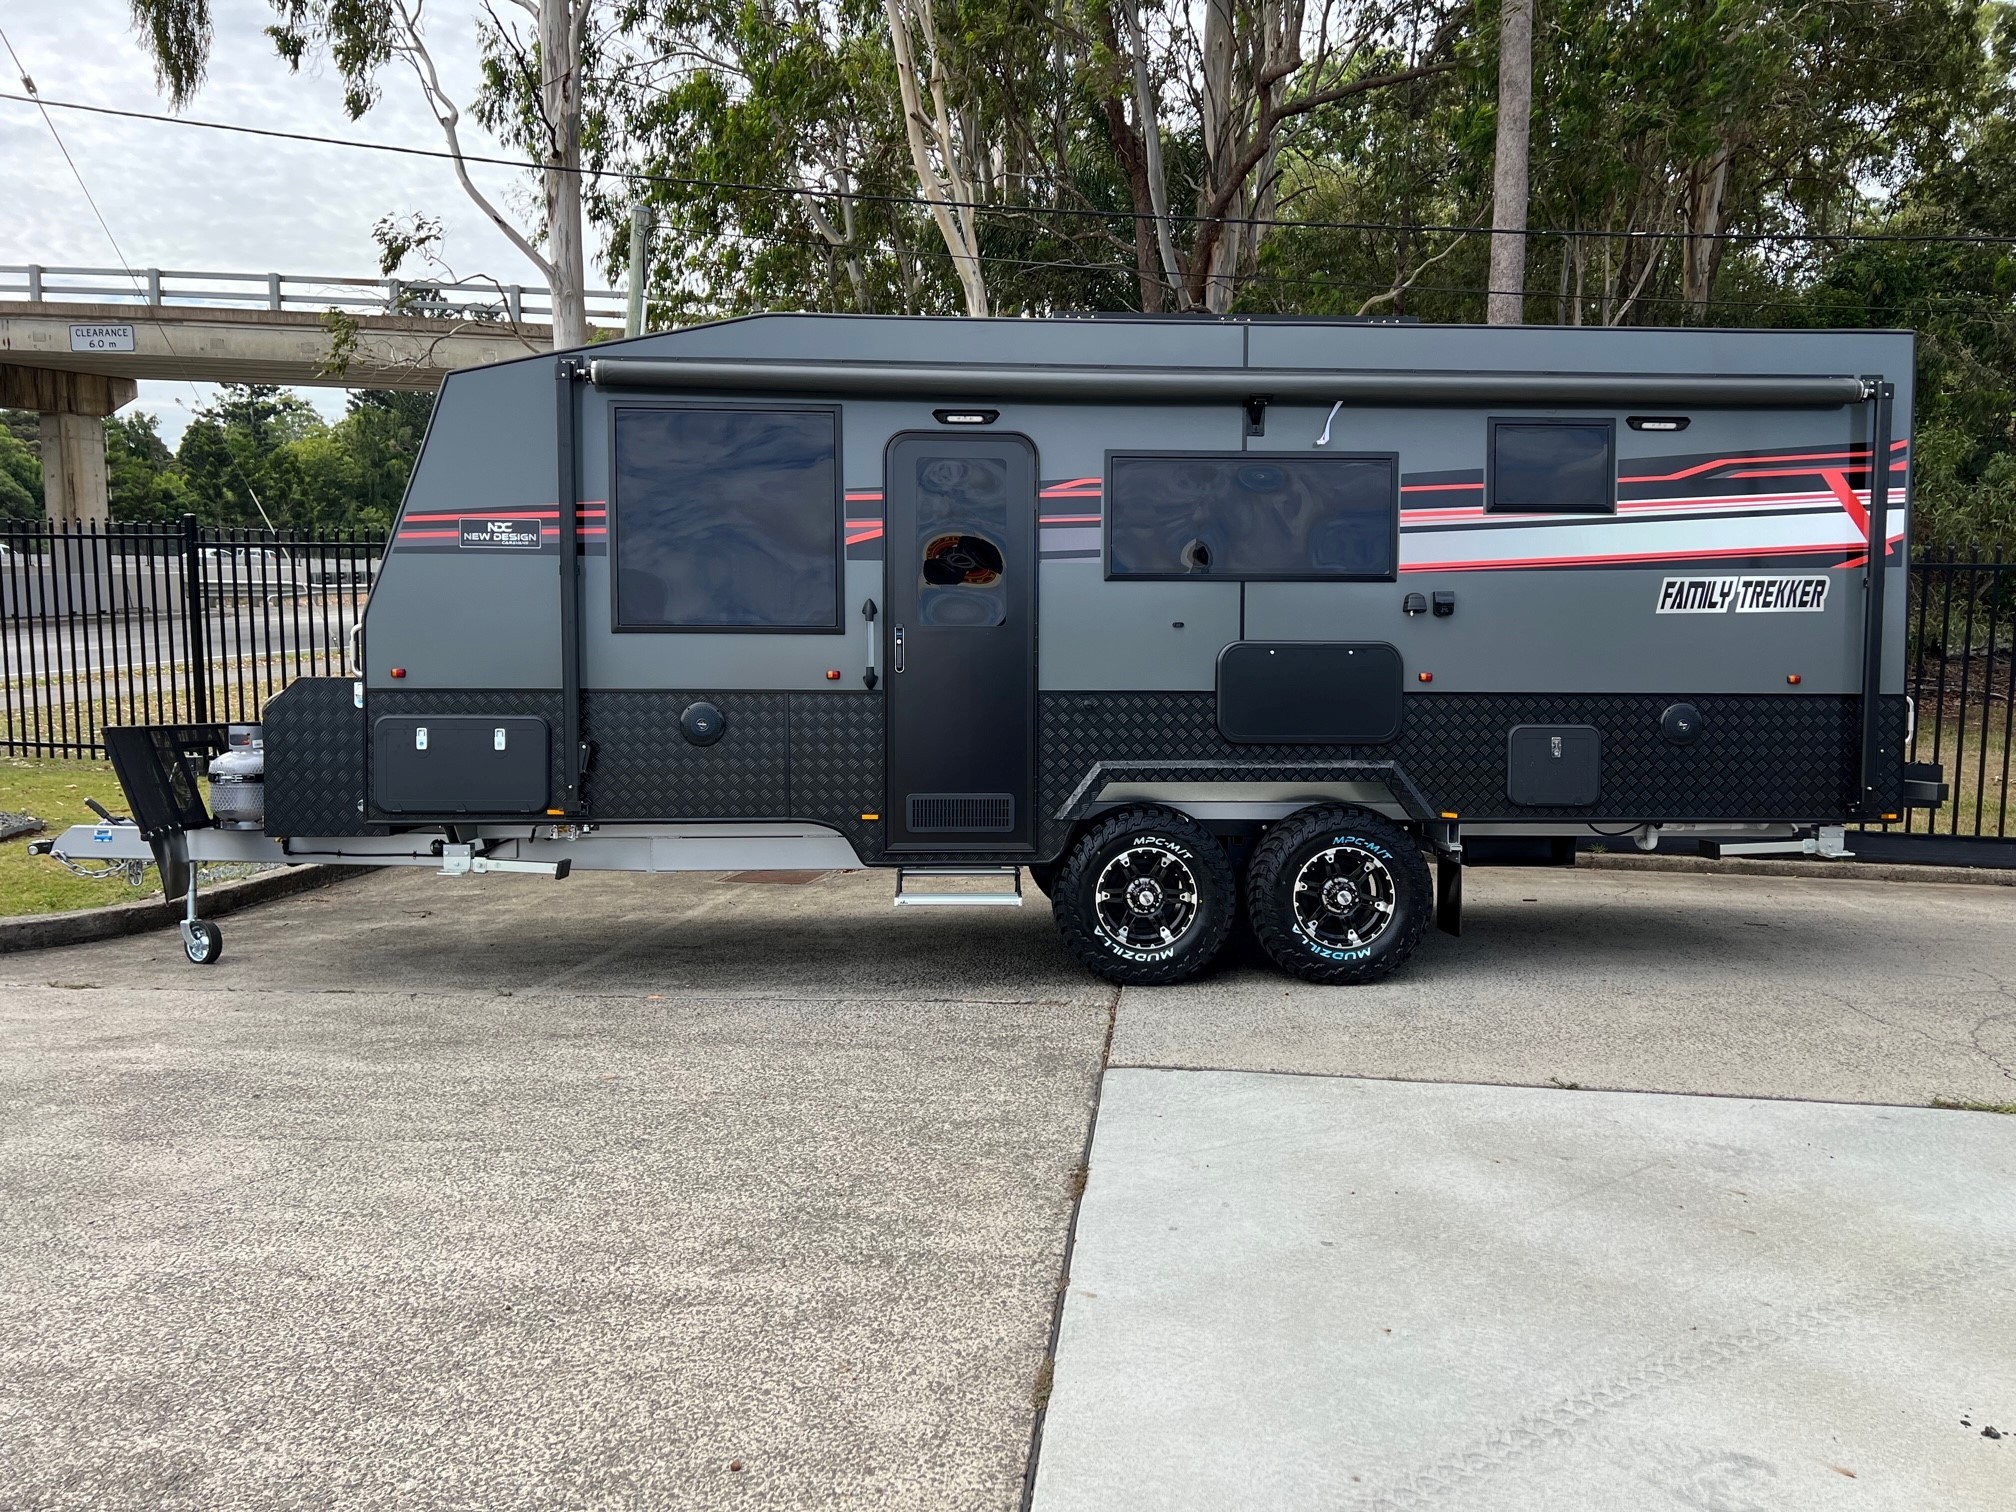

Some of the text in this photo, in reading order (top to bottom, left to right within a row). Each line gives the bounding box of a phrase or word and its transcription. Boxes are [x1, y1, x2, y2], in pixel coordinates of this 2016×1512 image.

[75, 328, 128, 337] CLEARANCE
[89, 339, 104, 348] 6.0
[487, 522, 513, 532] NDC
[463, 532, 537, 541] NEW DESIGN
[1660, 579, 1827, 610] FAMILY TREKKER
[1093, 925, 1175, 962] MUDZILLA
[1291, 923, 1371, 961] MUDZILLA
